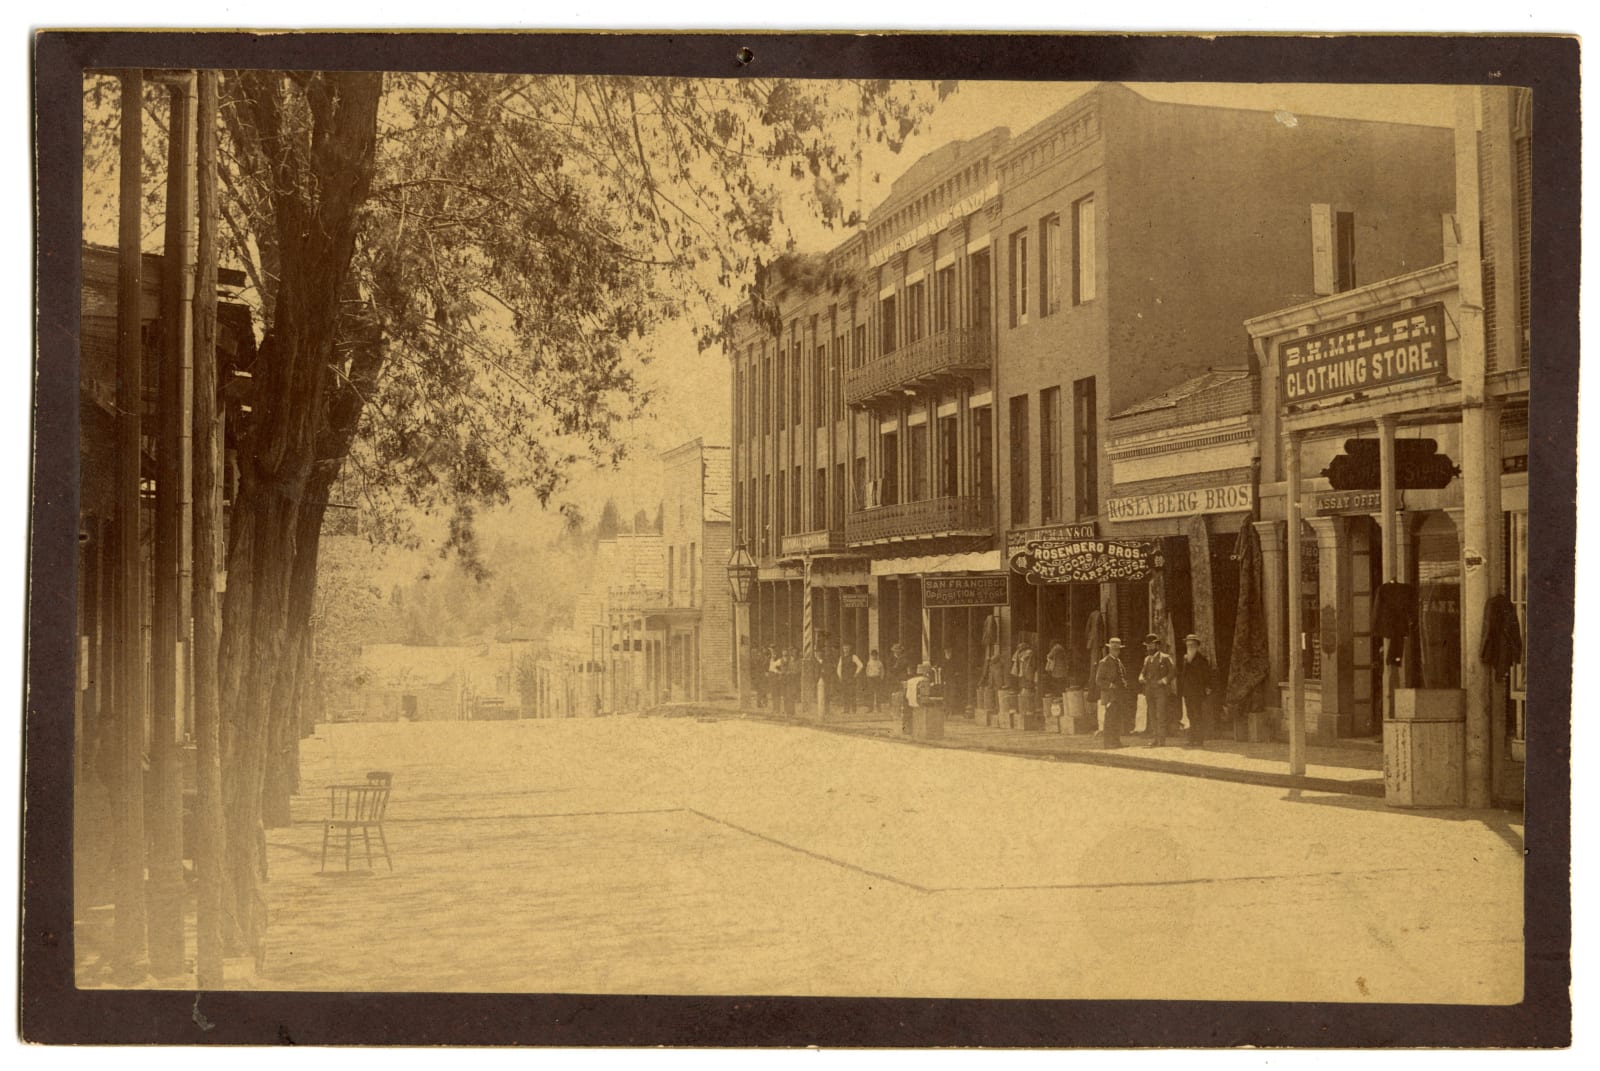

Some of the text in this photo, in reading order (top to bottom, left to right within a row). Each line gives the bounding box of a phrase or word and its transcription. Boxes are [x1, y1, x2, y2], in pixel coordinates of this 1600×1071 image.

[1286, 341, 1438, 398] CLOTHING STORE.
[1108, 490, 1198, 518] ROSENBERG
[1317, 493, 1380, 509] ASSAY OFFI
[1033, 541, 1104, 559] ROSENBERG
[1032, 552, 1092, 576] DRY GOODS
[1072, 558, 1117, 580] CARPET
[926, 579, 1006, 589] SAN FRANCISCO
[925, 590, 975, 600] OPPOSITION
